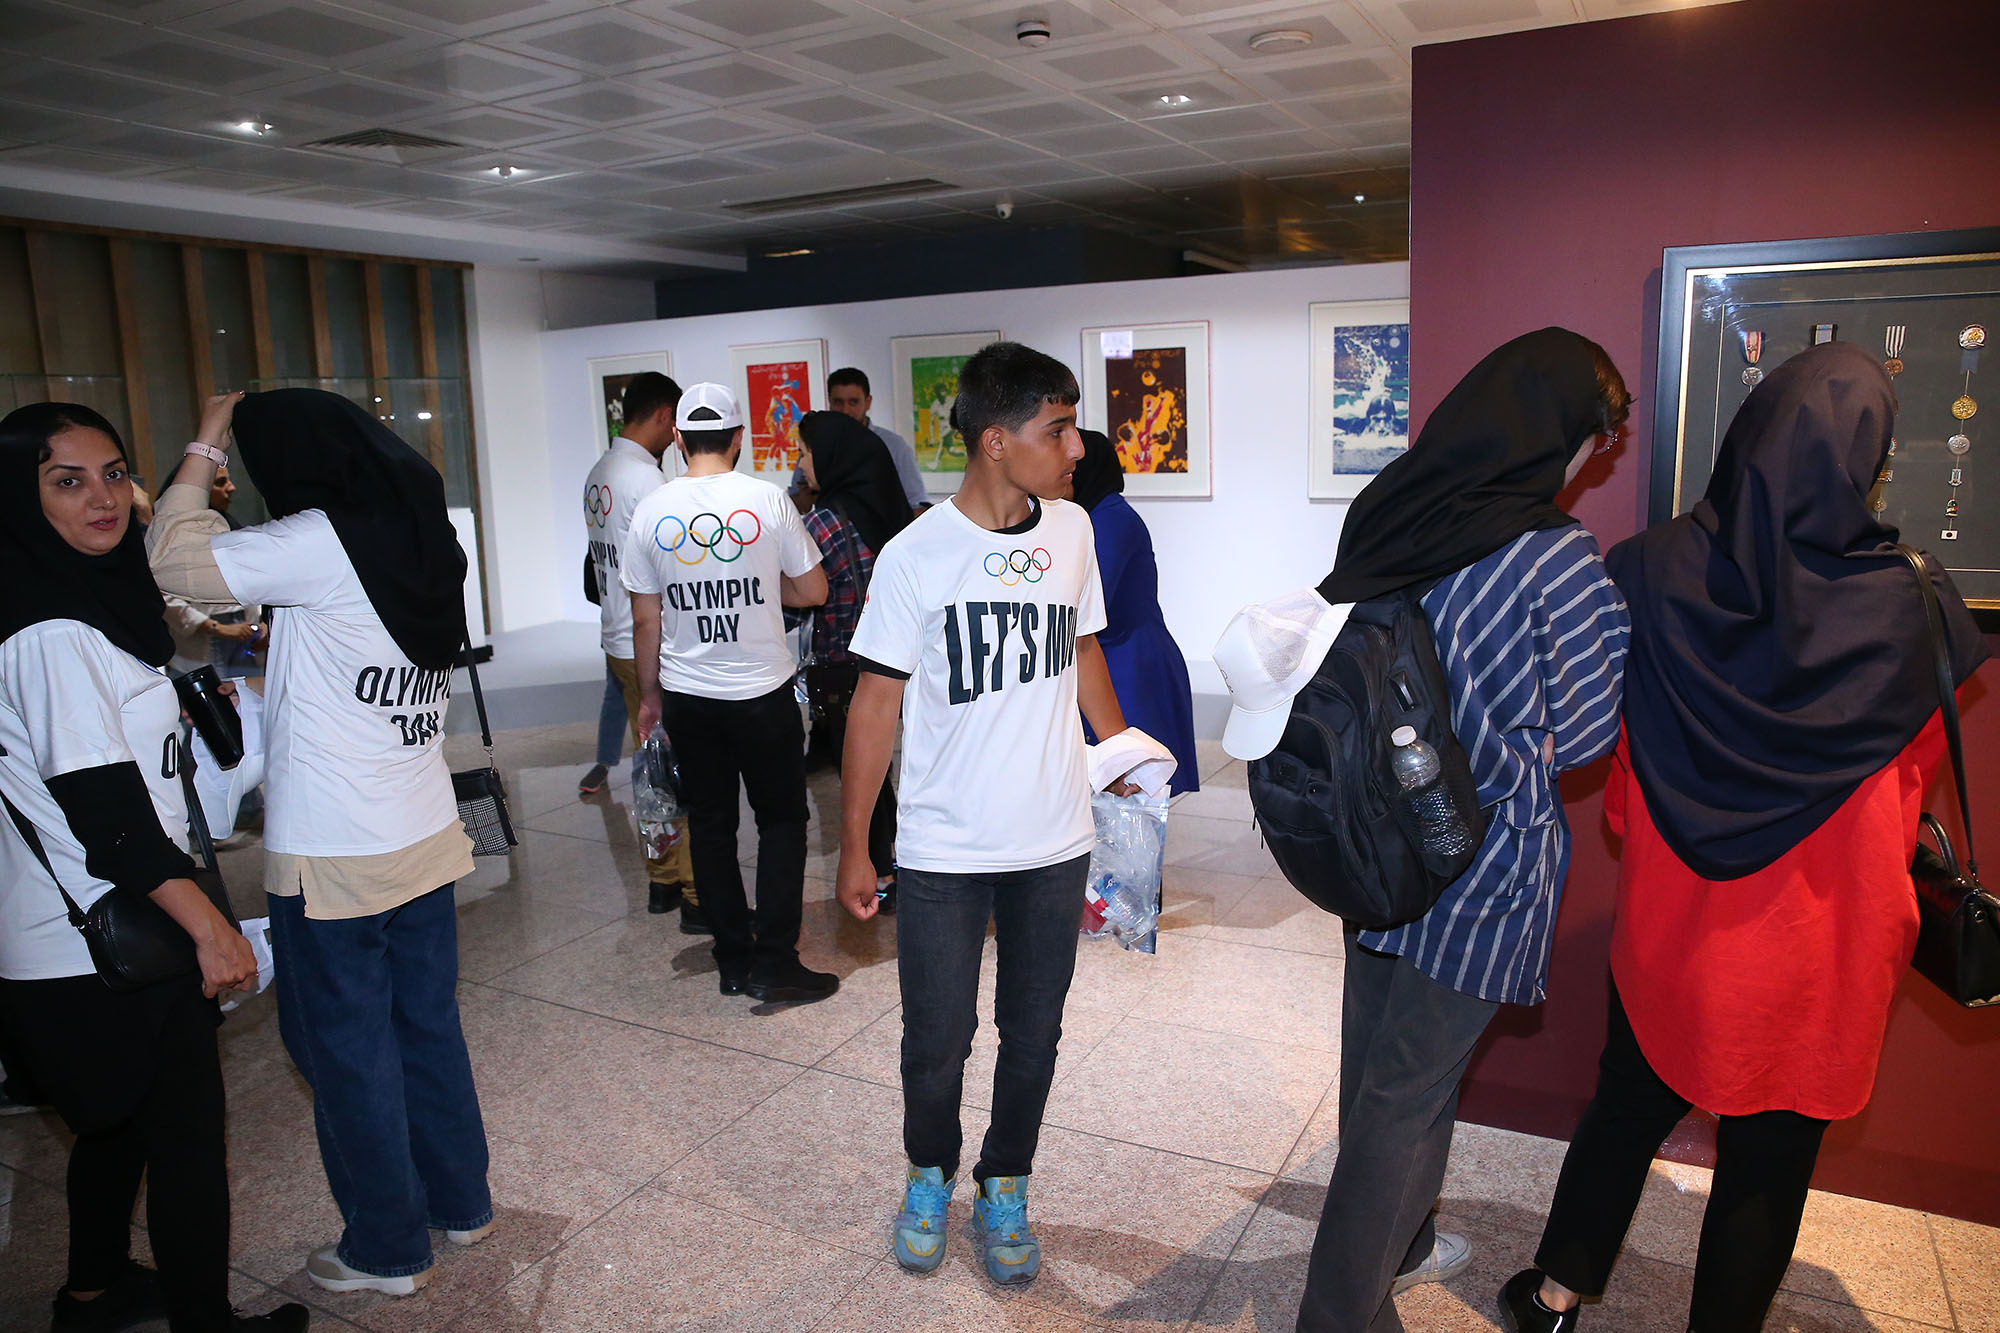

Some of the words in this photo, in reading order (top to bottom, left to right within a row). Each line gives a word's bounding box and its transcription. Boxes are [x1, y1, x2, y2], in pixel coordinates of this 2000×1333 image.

[666, 577, 765, 611] OLYMPIC
[697, 614, 740, 643] DAY
[944, 602, 1039, 705] LET'S
[390, 711, 440, 746] DAY
